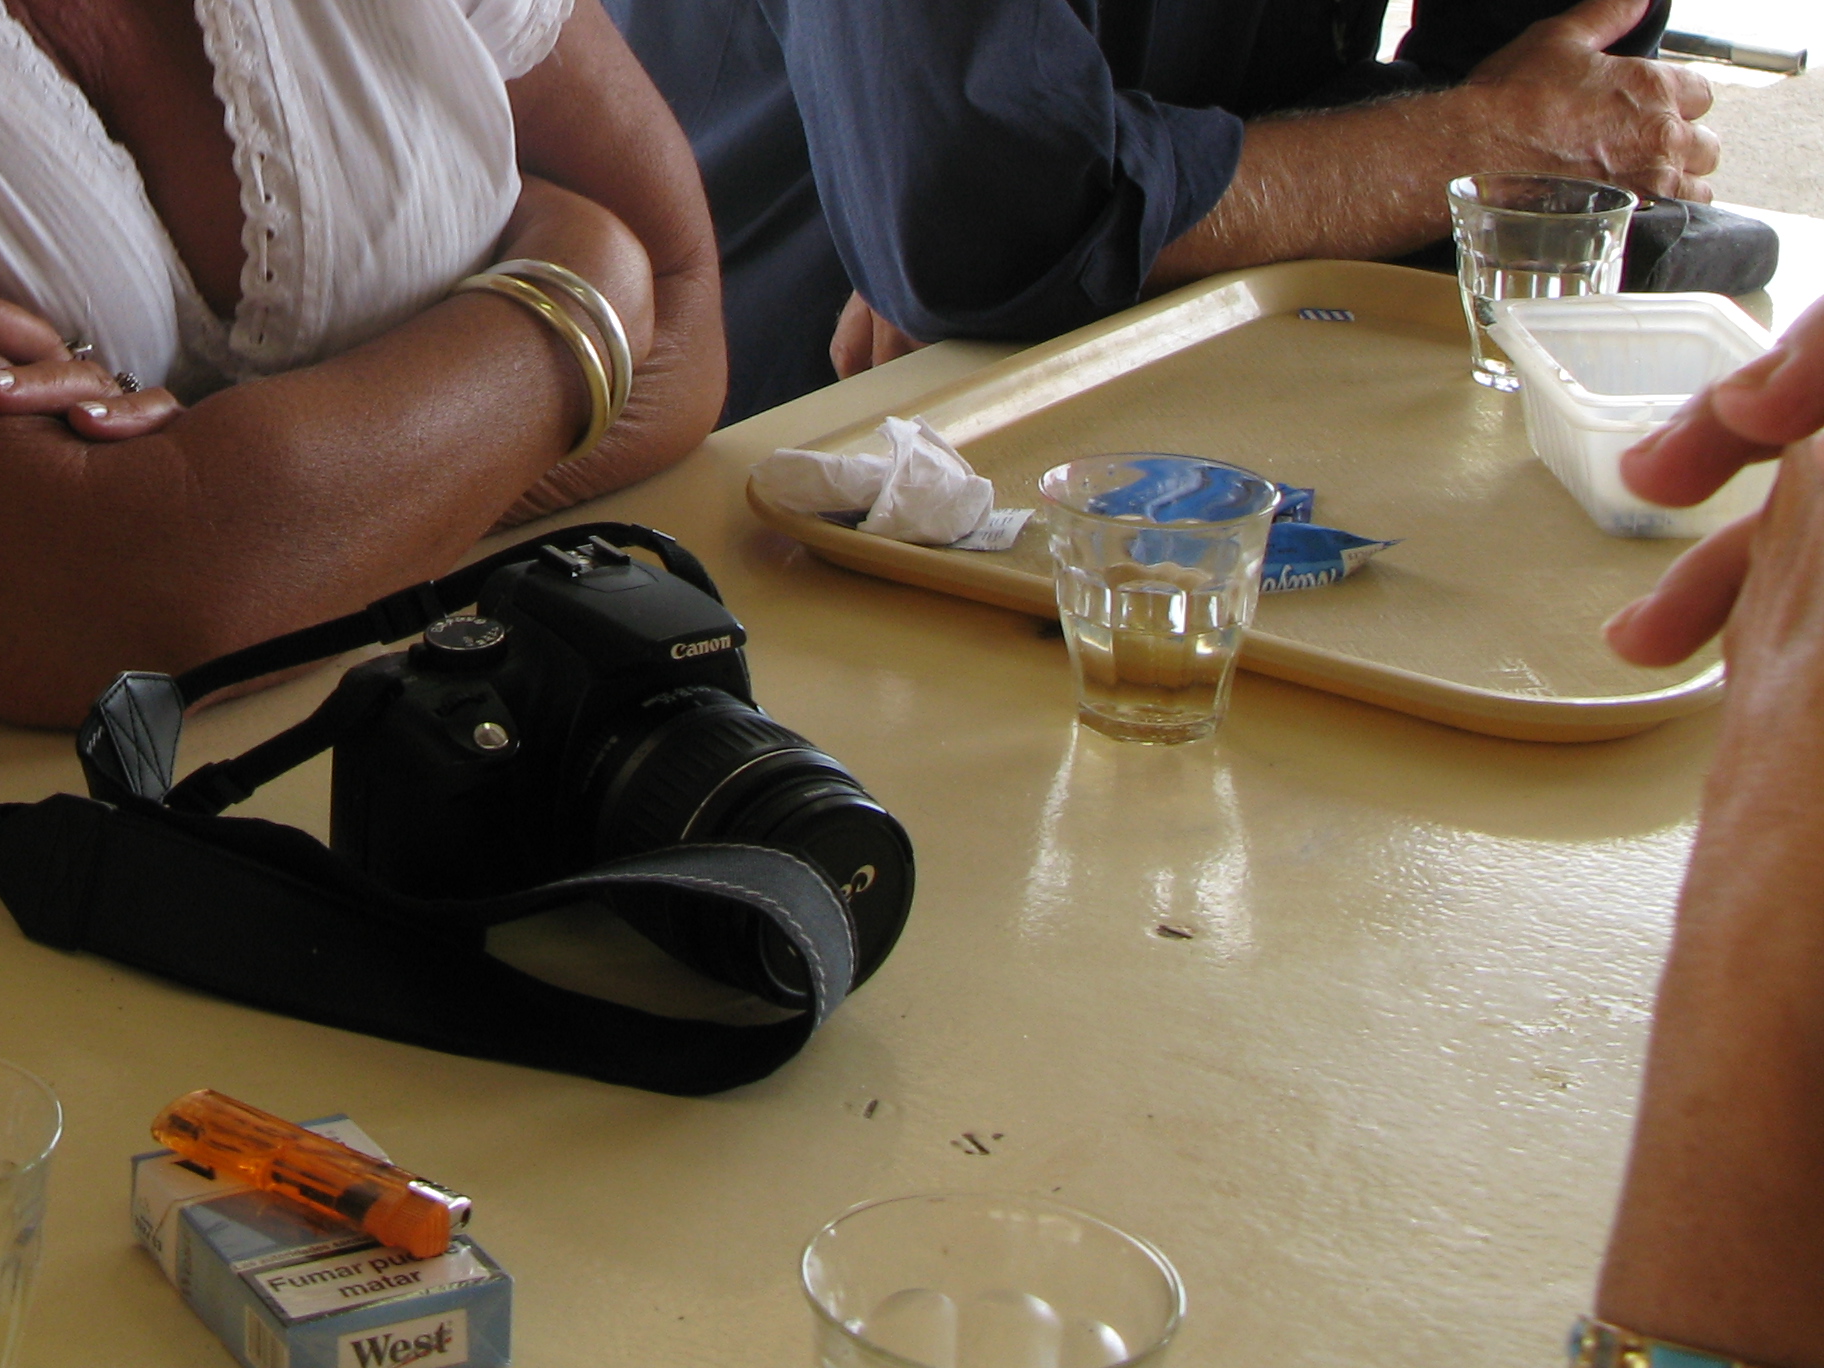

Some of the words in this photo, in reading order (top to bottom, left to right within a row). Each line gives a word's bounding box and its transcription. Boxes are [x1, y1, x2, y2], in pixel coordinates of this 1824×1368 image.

[670, 635, 732, 660] Canon
[266, 1261, 364, 1294] Fumar
[338, 1268, 423, 1299] matar
[350, 1322, 450, 1368] West
